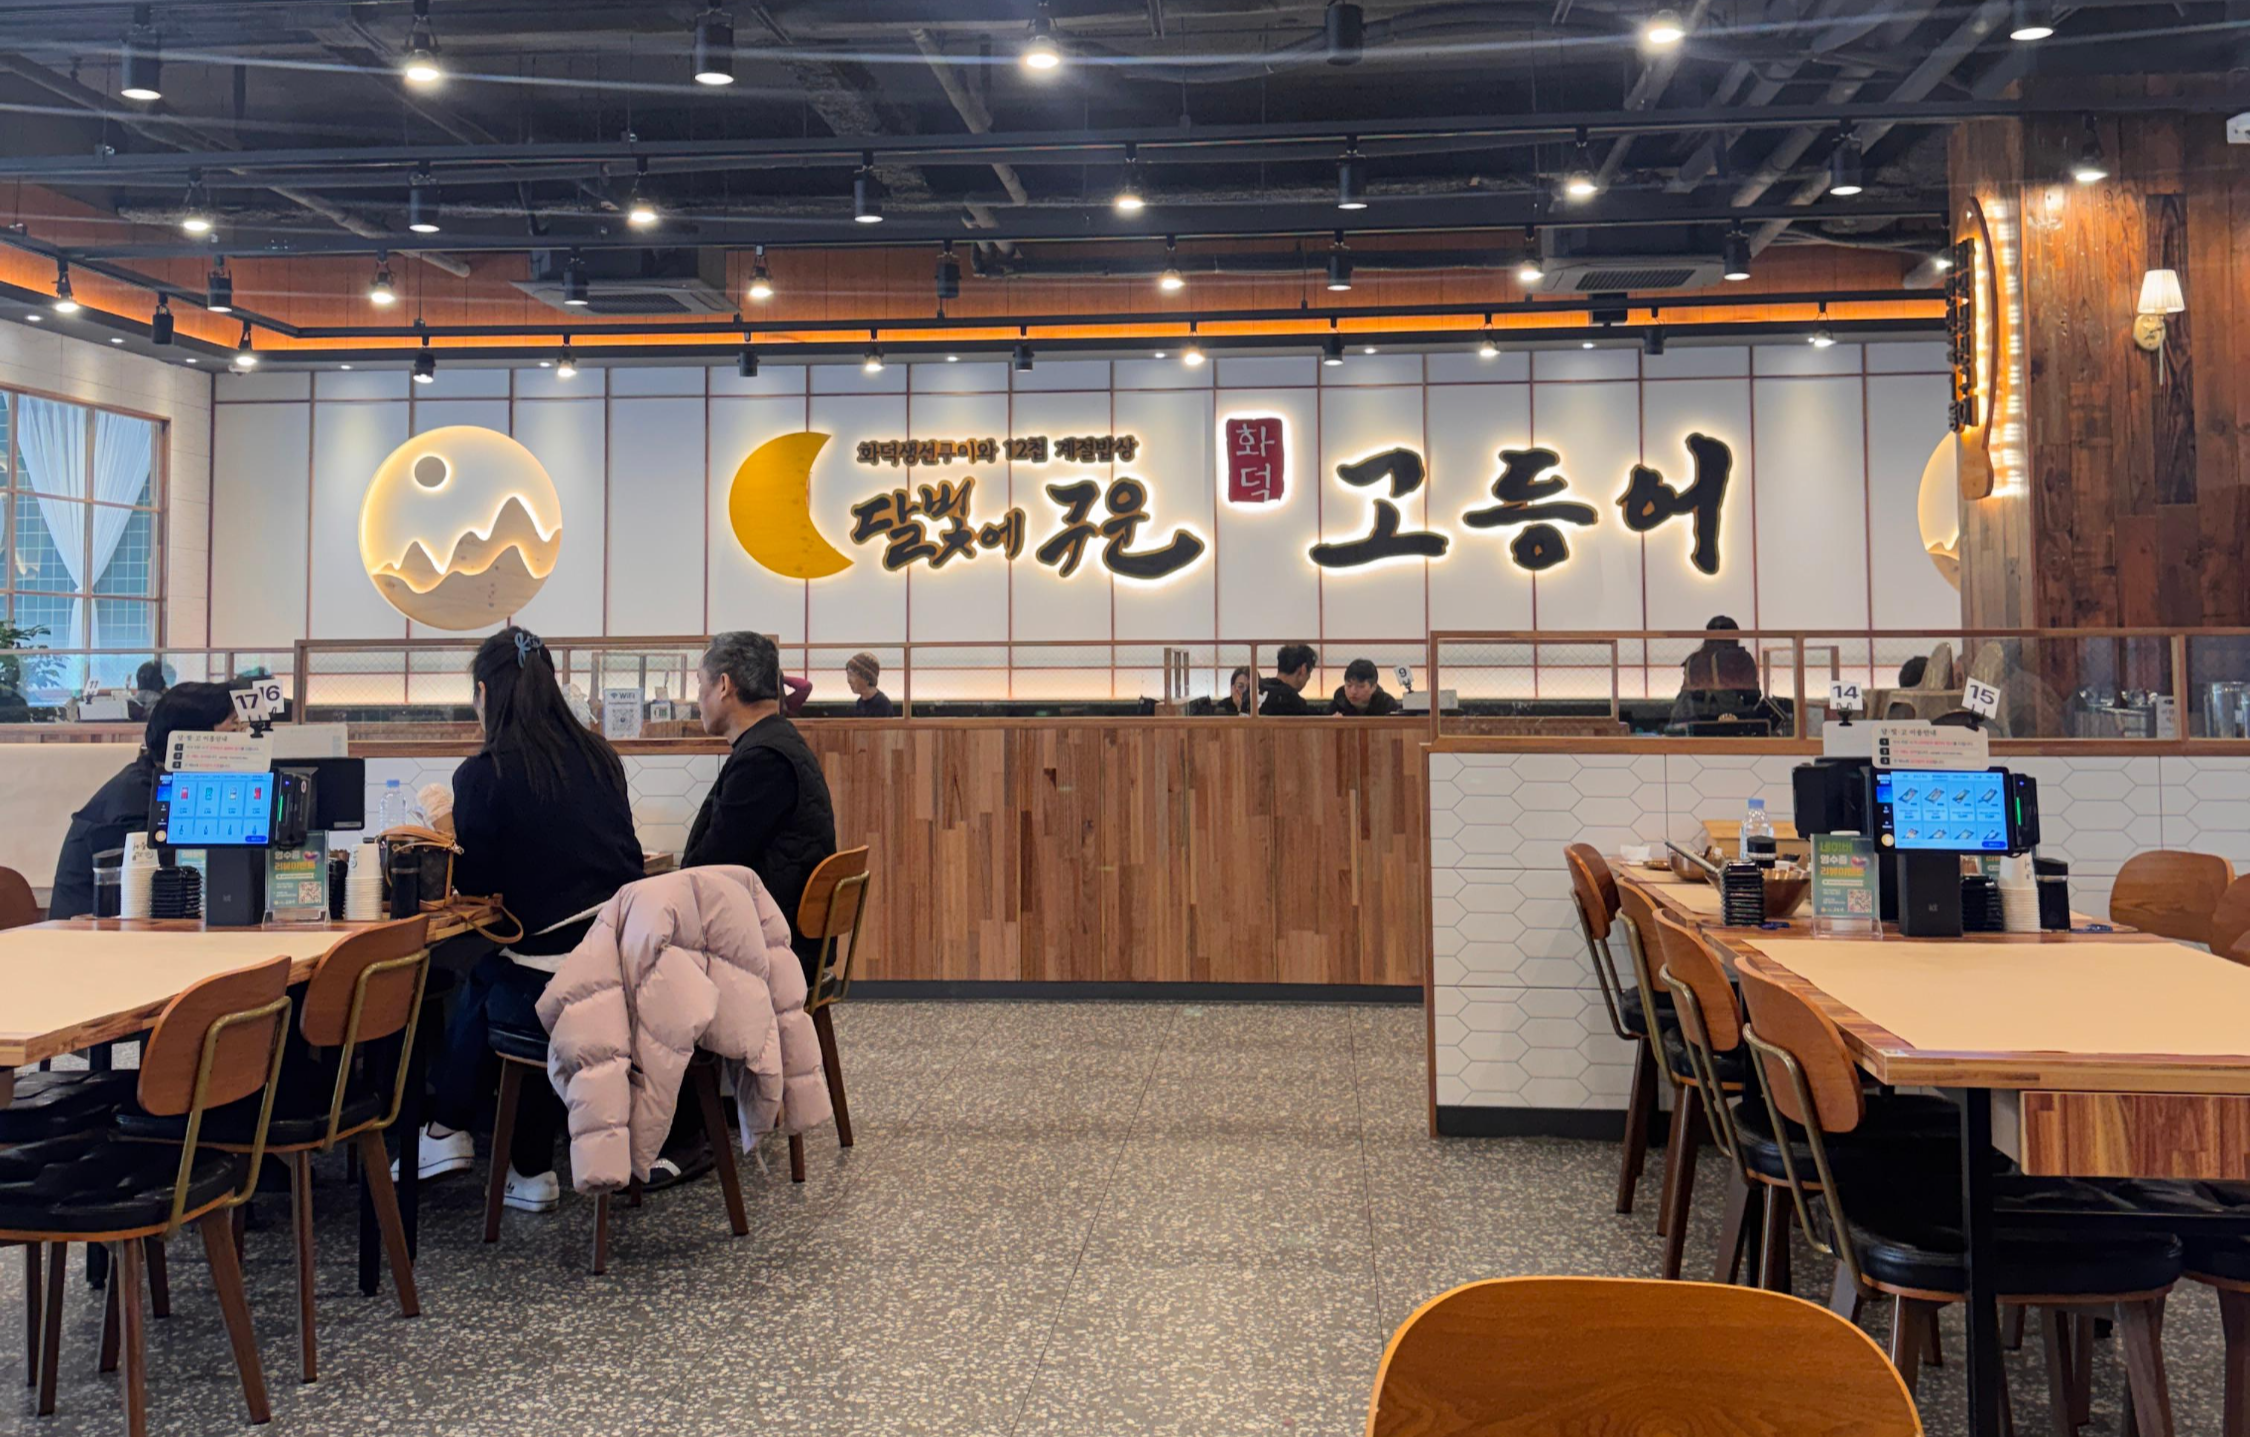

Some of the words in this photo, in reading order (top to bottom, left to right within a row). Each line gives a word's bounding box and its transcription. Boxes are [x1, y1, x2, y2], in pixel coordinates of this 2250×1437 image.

[857, 437, 1000, 468] 화덕생선구이와
[1003, 435, 1049, 464] 12첩
[1053, 434, 1140, 464] 계절밥상
[1235, 422, 1276, 500] 화덕
[850, 477, 1026, 574] 달빛에
[1036, 477, 1206, 580] 구운
[1308, 431, 1733, 575] 고등어
[1398, 667, 1407, 678] 9
[235, 693, 259, 710] 17
[1832, 685, 1859, 699] 14
[1969, 684, 1996, 705] 15
